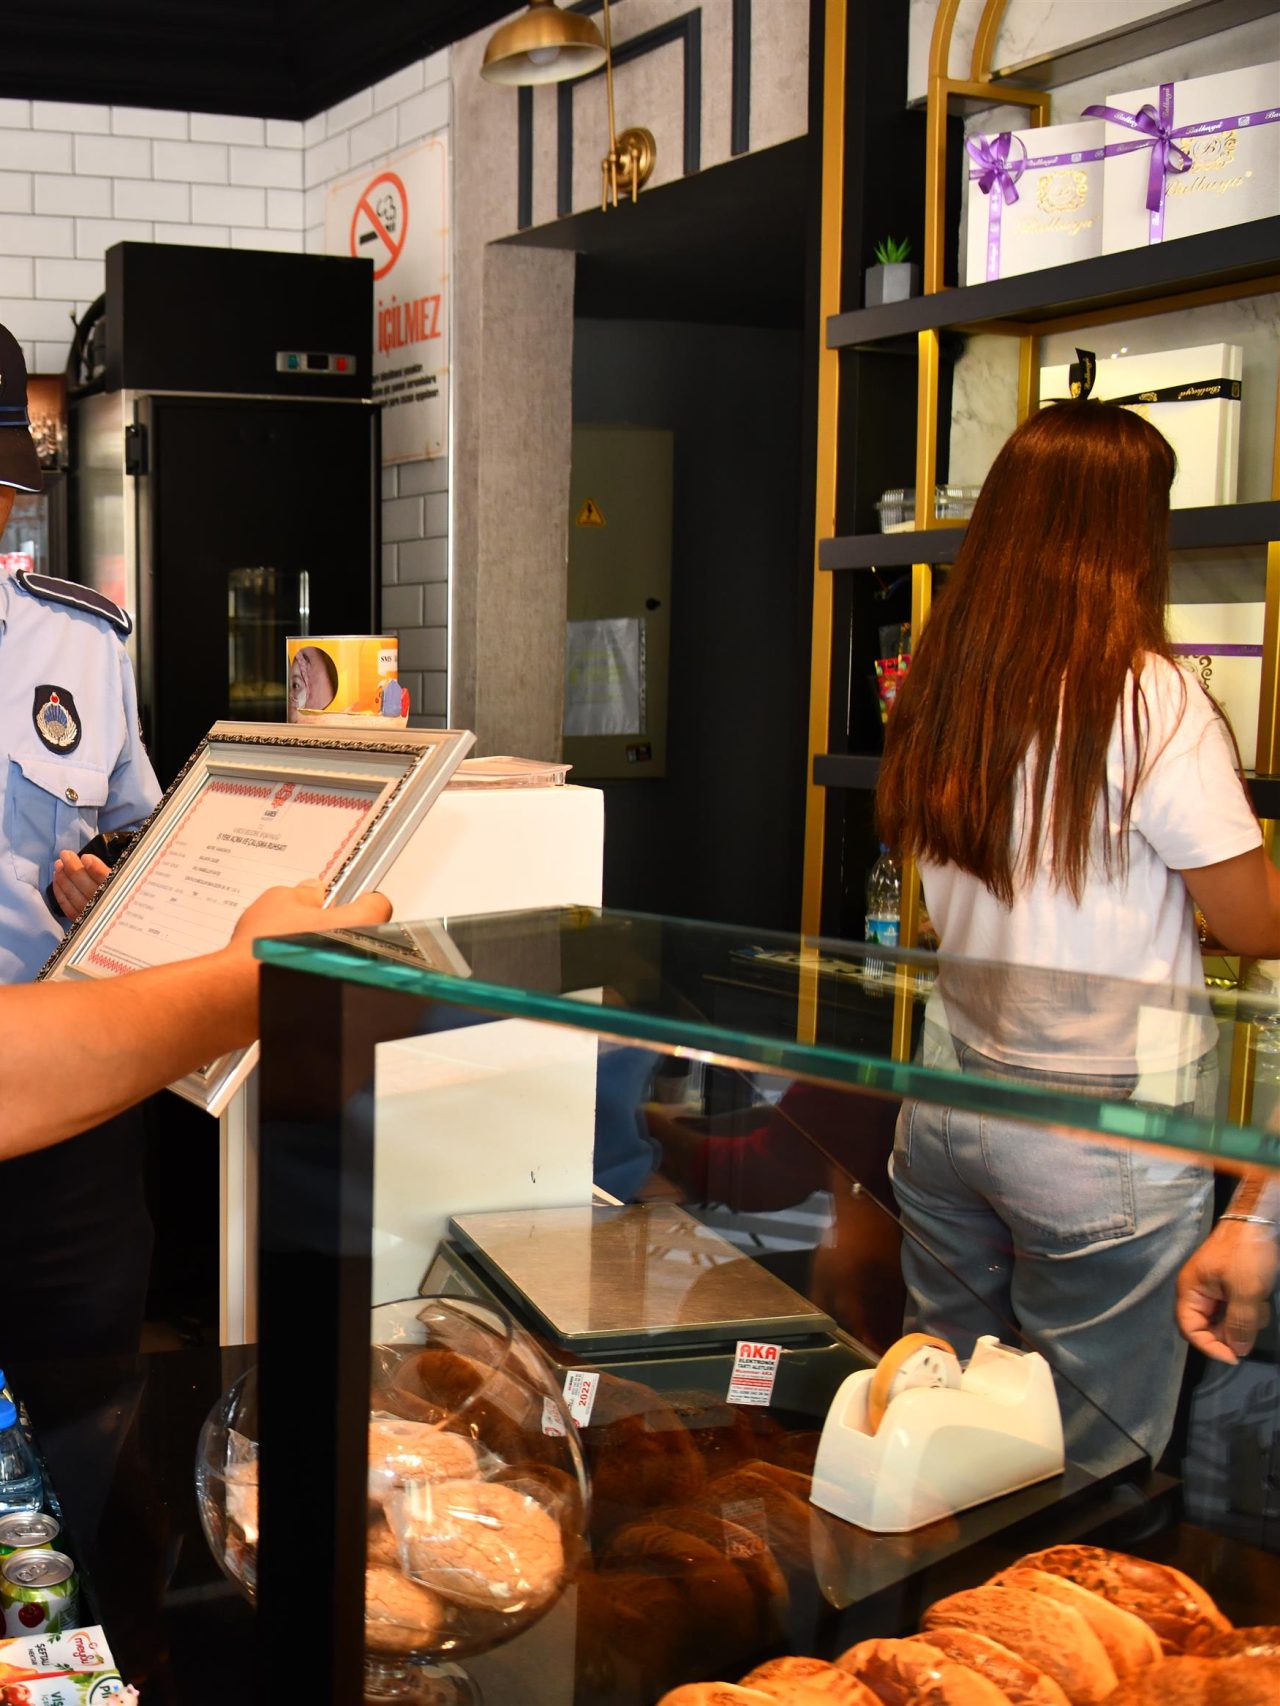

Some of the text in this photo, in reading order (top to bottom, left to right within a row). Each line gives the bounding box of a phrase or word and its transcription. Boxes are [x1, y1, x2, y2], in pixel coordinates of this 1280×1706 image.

[377, 293, 443, 358] İÇİLMEZ
[739, 1343, 778, 1360] AKA
[578, 1380, 592, 1407] 2022
